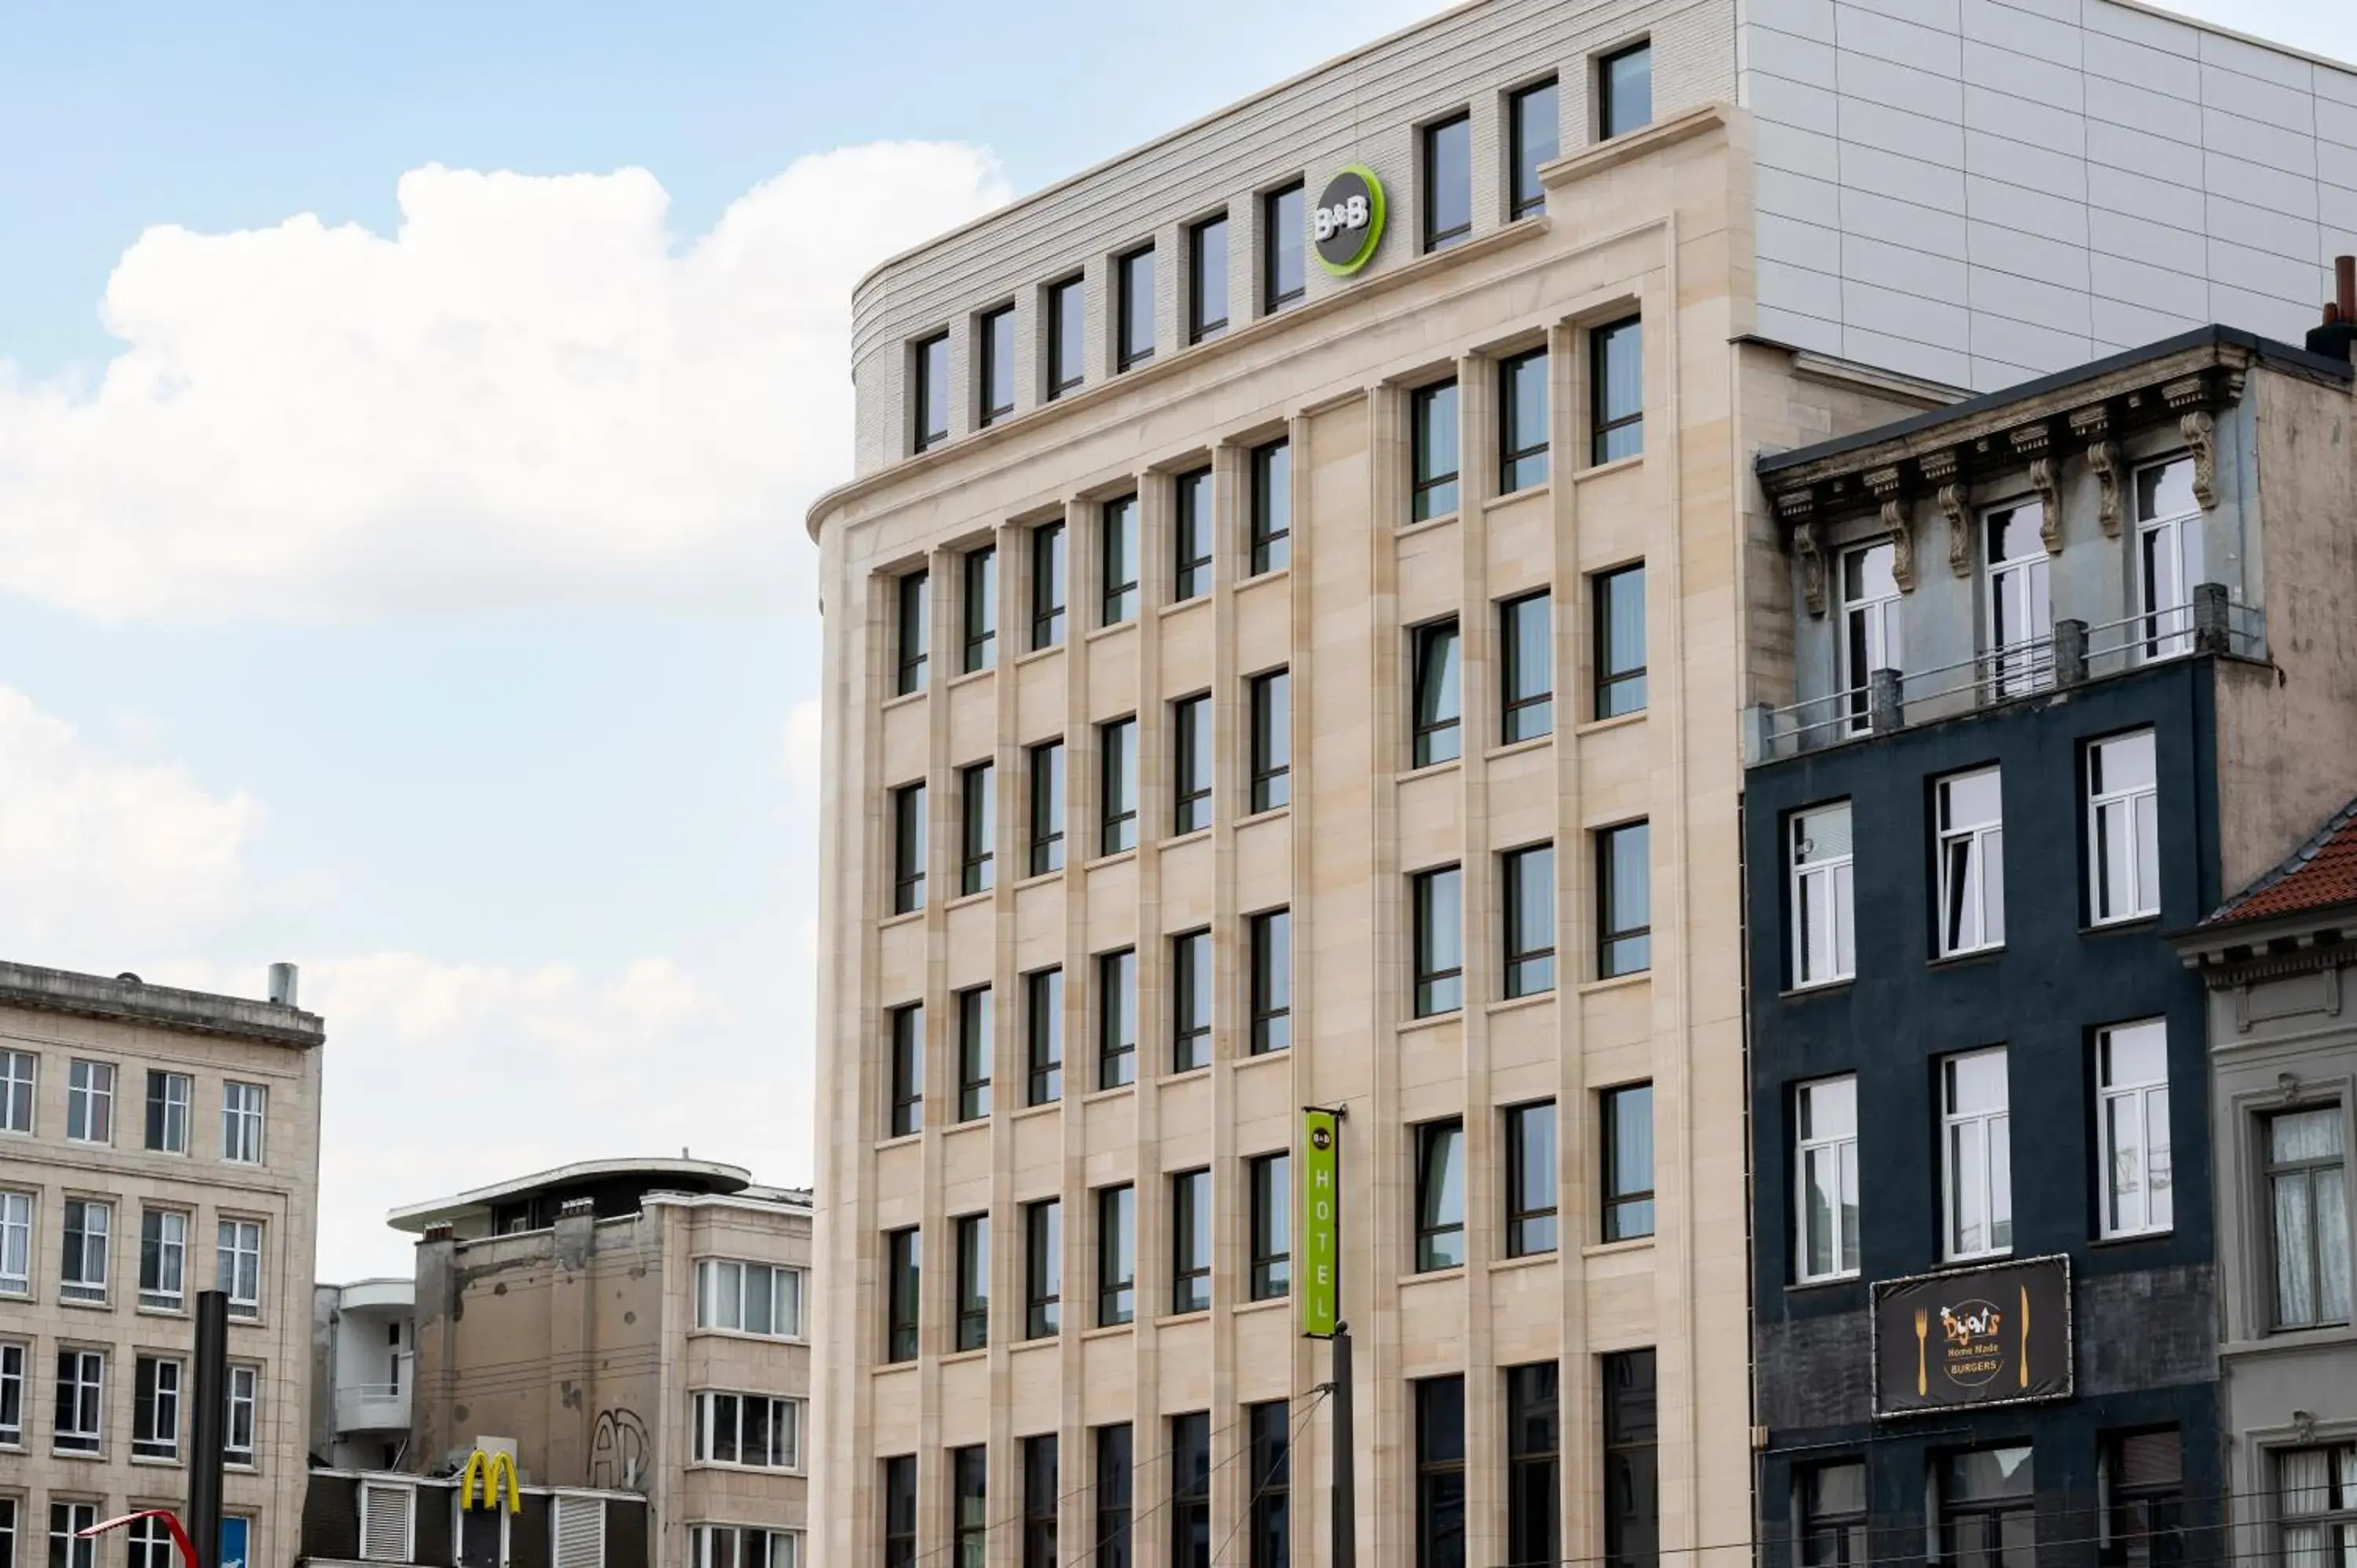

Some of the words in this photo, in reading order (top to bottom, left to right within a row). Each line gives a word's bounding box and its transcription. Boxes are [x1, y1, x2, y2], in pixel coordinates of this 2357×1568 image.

[1314, 195, 1367, 240] B&B
[1316, 1169, 1329, 1317] HOTEL
[1951, 1361, 1996, 1374] BURGERS
